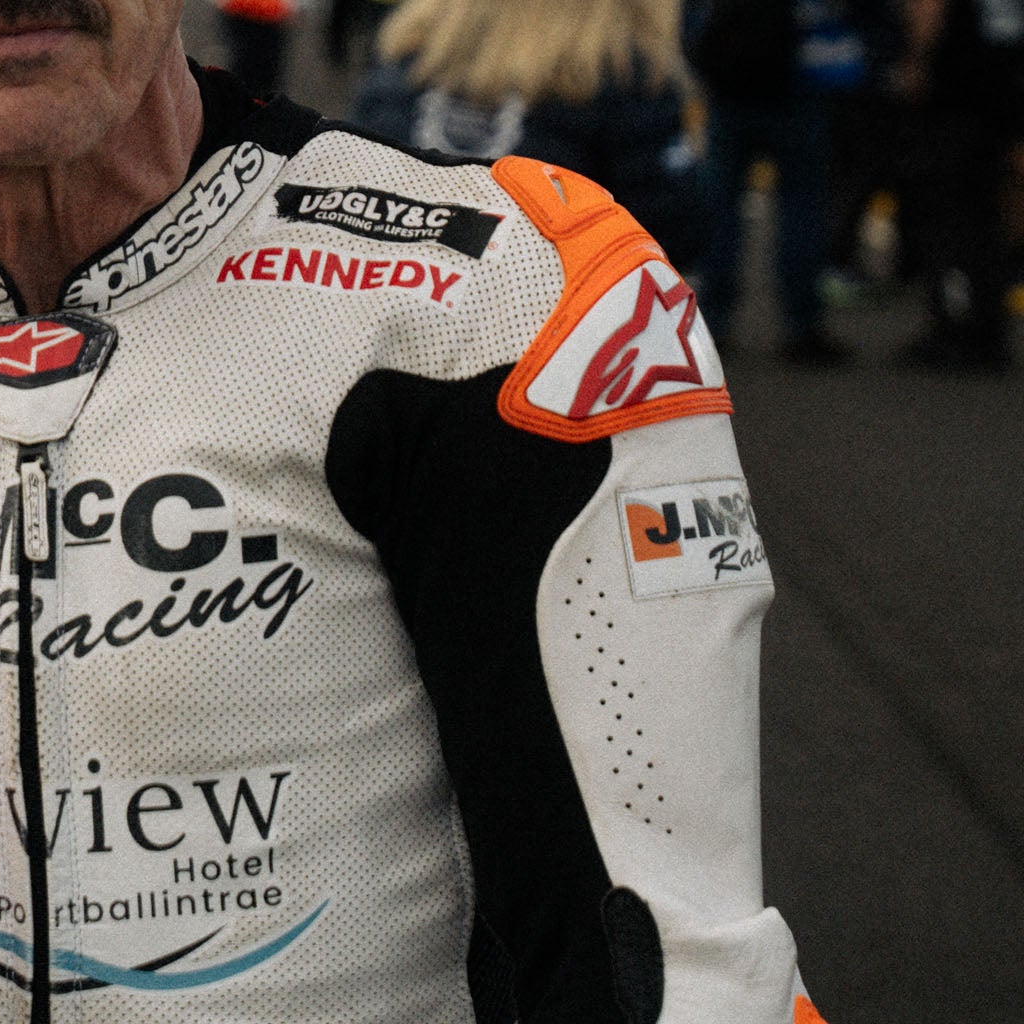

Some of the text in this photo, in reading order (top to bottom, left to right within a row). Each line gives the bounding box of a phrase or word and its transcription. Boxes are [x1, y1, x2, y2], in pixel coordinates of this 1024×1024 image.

[64, 140, 265, 314] alpinestars
[314, 210, 374, 231] CLOTHING
[384, 224, 444, 238] LIFESTYLE
[216, 247, 463, 304] KENNEDY
[173, 847, 275, 884] Hotel
